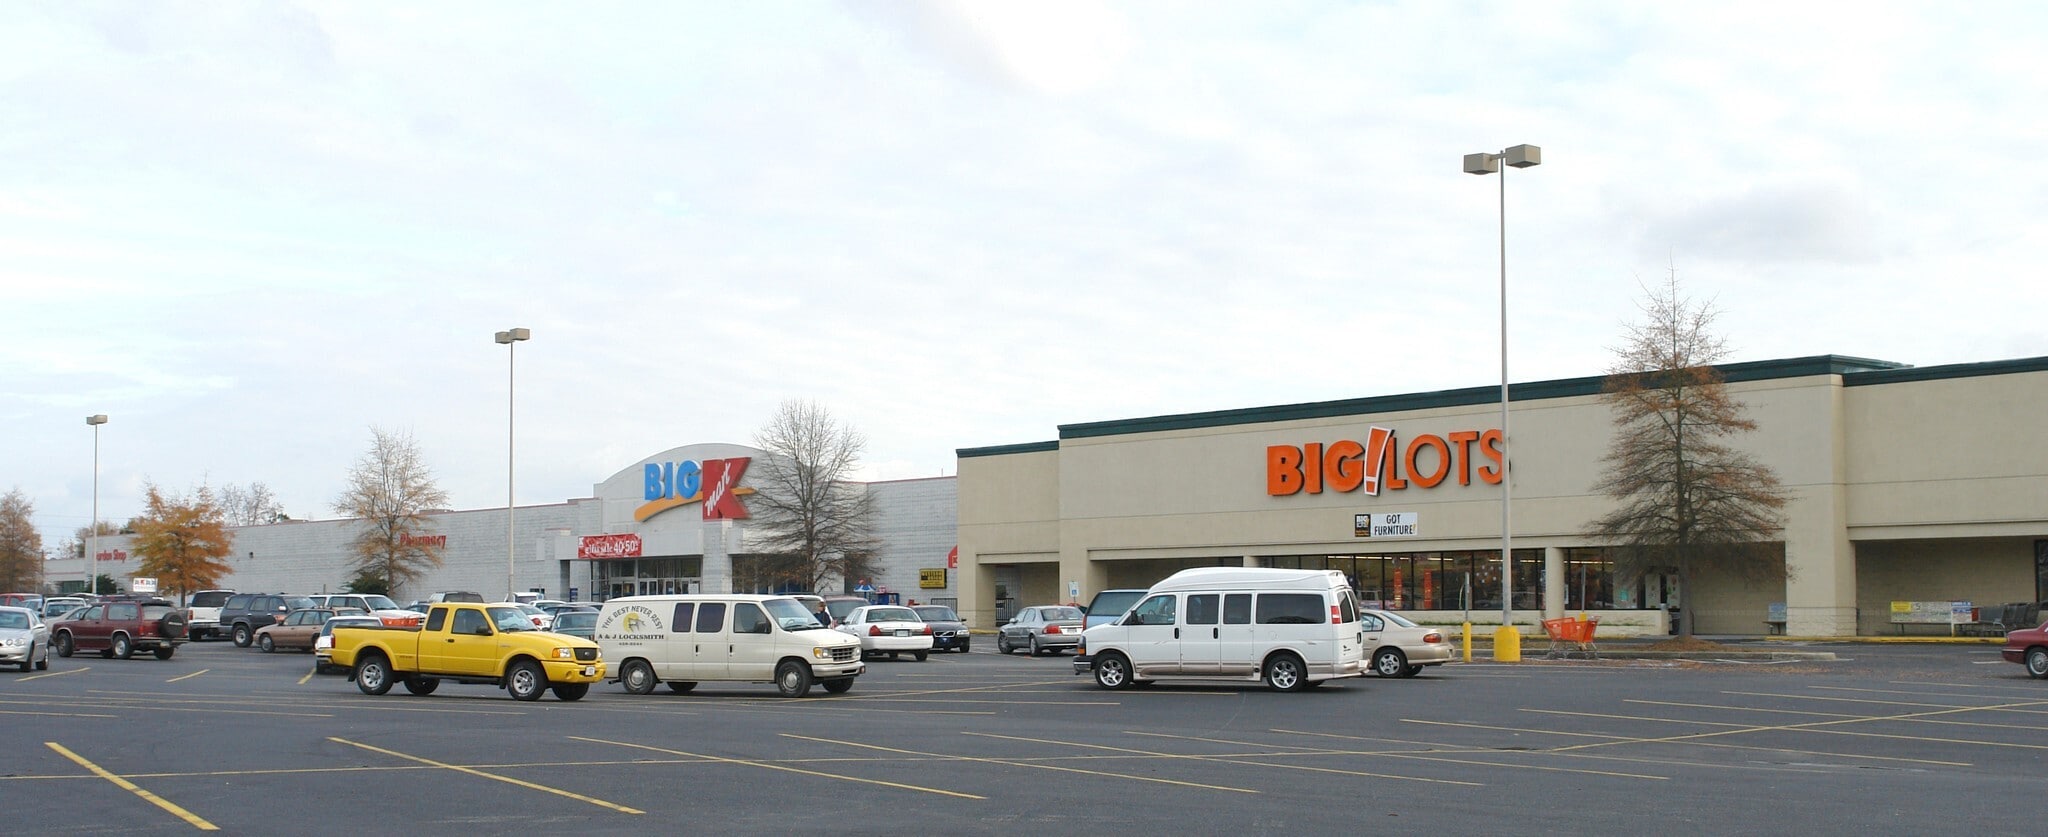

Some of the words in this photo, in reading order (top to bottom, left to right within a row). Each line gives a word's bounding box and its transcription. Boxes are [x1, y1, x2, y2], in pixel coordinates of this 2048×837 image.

[1386, 429, 1504, 489] LOTS
[644, 460, 702, 501] BIG
[702, 457, 752, 520] K
[705, 462, 731, 516] mart
[1386, 514, 1401, 524] GOT
[602, 616, 614, 629] THE
[613, 606, 630, 618] BEST
[631, 605, 653, 617] NEVER
[650, 614, 664, 630] REST
